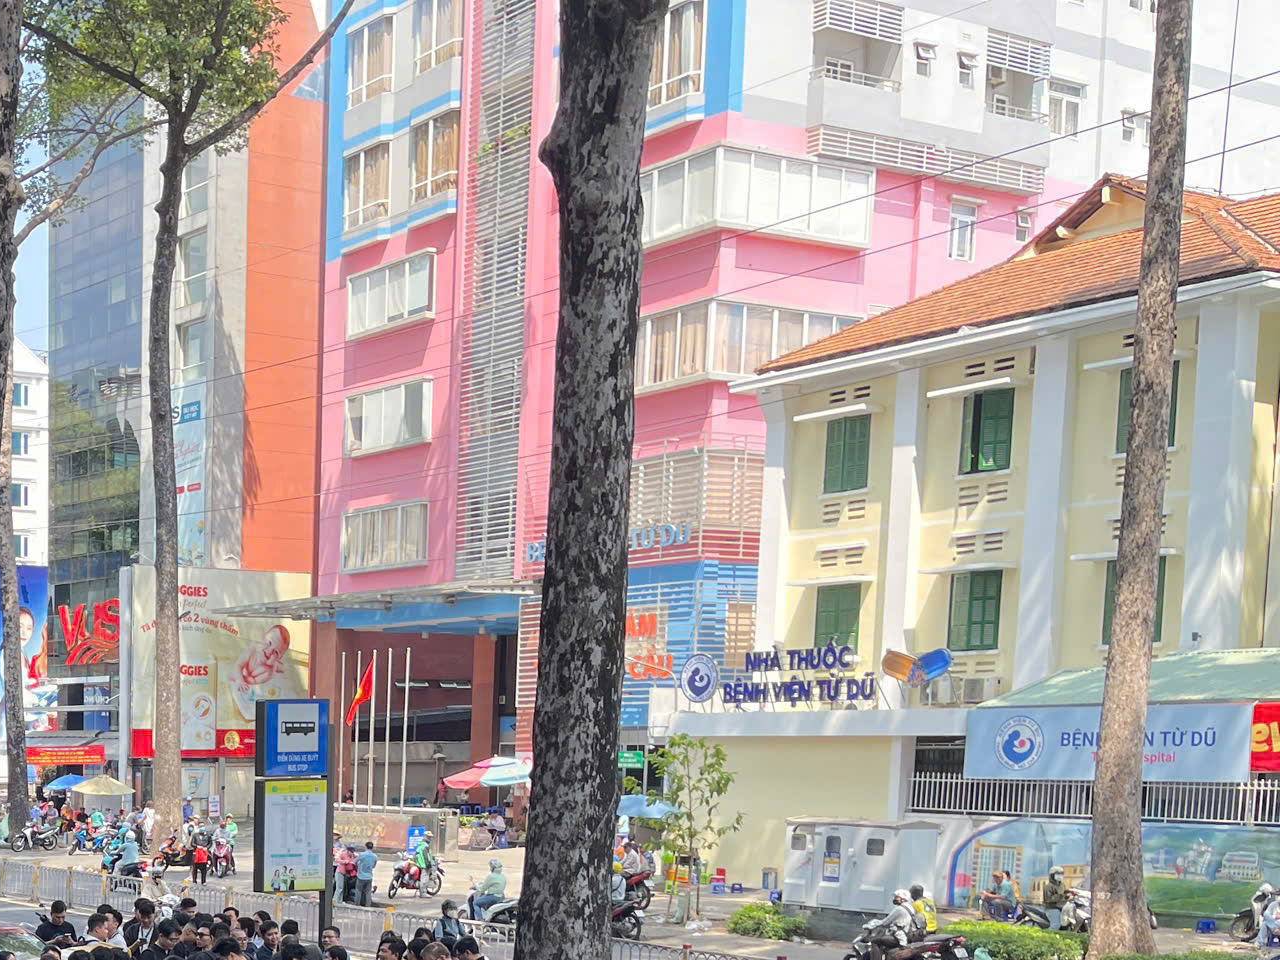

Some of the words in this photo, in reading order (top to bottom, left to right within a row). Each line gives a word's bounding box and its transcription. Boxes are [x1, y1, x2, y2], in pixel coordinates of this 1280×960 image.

[178, 585, 208, 597] GGIES
[745, 645, 781, 672] NHÀ
[787, 636, 852, 671] THUỐC
[179, 665, 208, 677] GGIES
[723, 677, 767, 708] BỆNH
[847, 671, 875, 701] DŨ
[1160, 727, 1187, 747] TỪ
[1191, 728, 1216, 746] DŨ
[1144, 752, 1176, 765] spital
